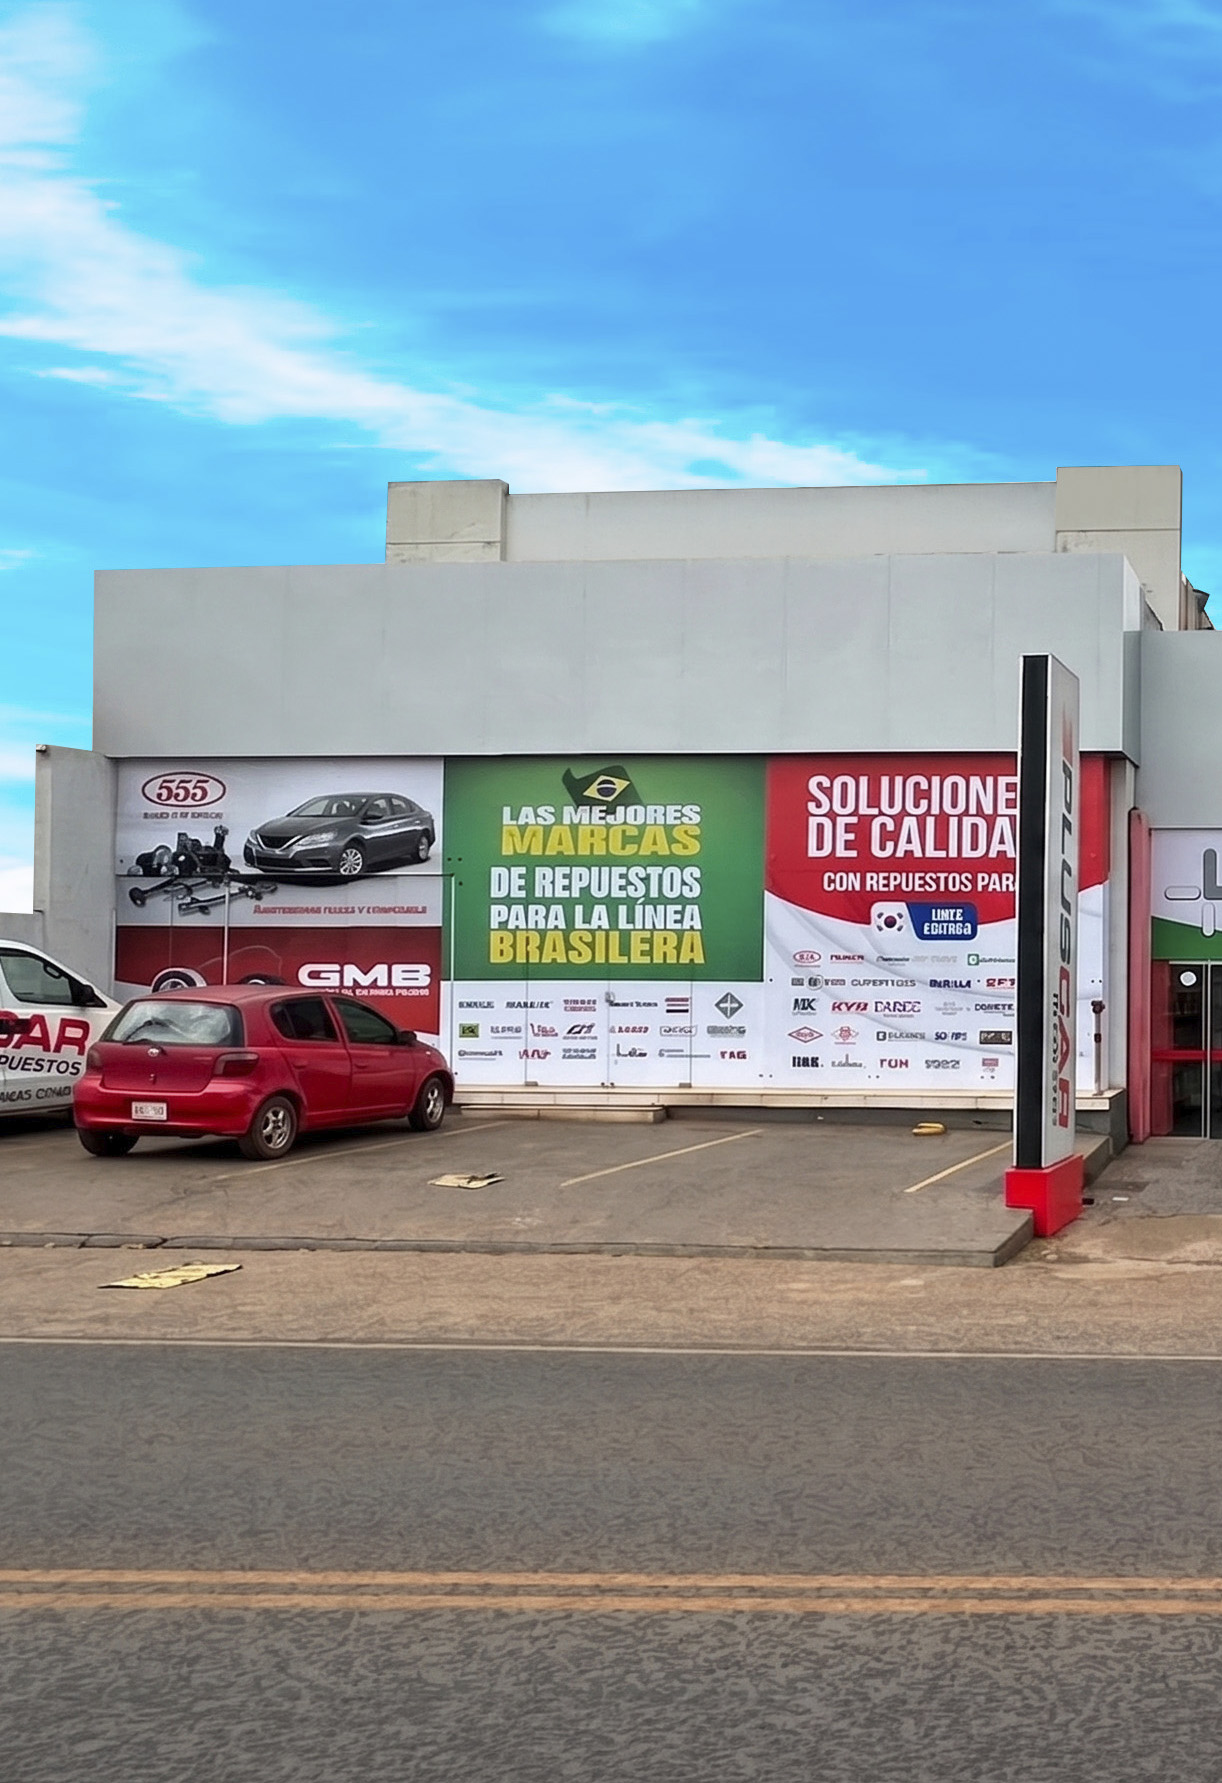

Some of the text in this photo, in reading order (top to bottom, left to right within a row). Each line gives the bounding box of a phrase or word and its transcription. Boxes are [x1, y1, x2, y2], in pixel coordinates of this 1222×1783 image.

[156, 779, 210, 802] 555
[807, 775, 1018, 815] SOLUCIONE
[503, 805, 701, 825] LAS MEJORES
[501, 825, 701, 856] MARCAS
[807, 816, 1016, 858] DE CALIDA
[490, 866, 701, 899] DE REPUESTOS
[823, 872, 1016, 892] CON REPUESTOS PAR
[490, 897, 702, 930] PARA LA LÍNEA
[489, 931, 705, 964] BRASILERA
[298, 963, 431, 987] GMB
